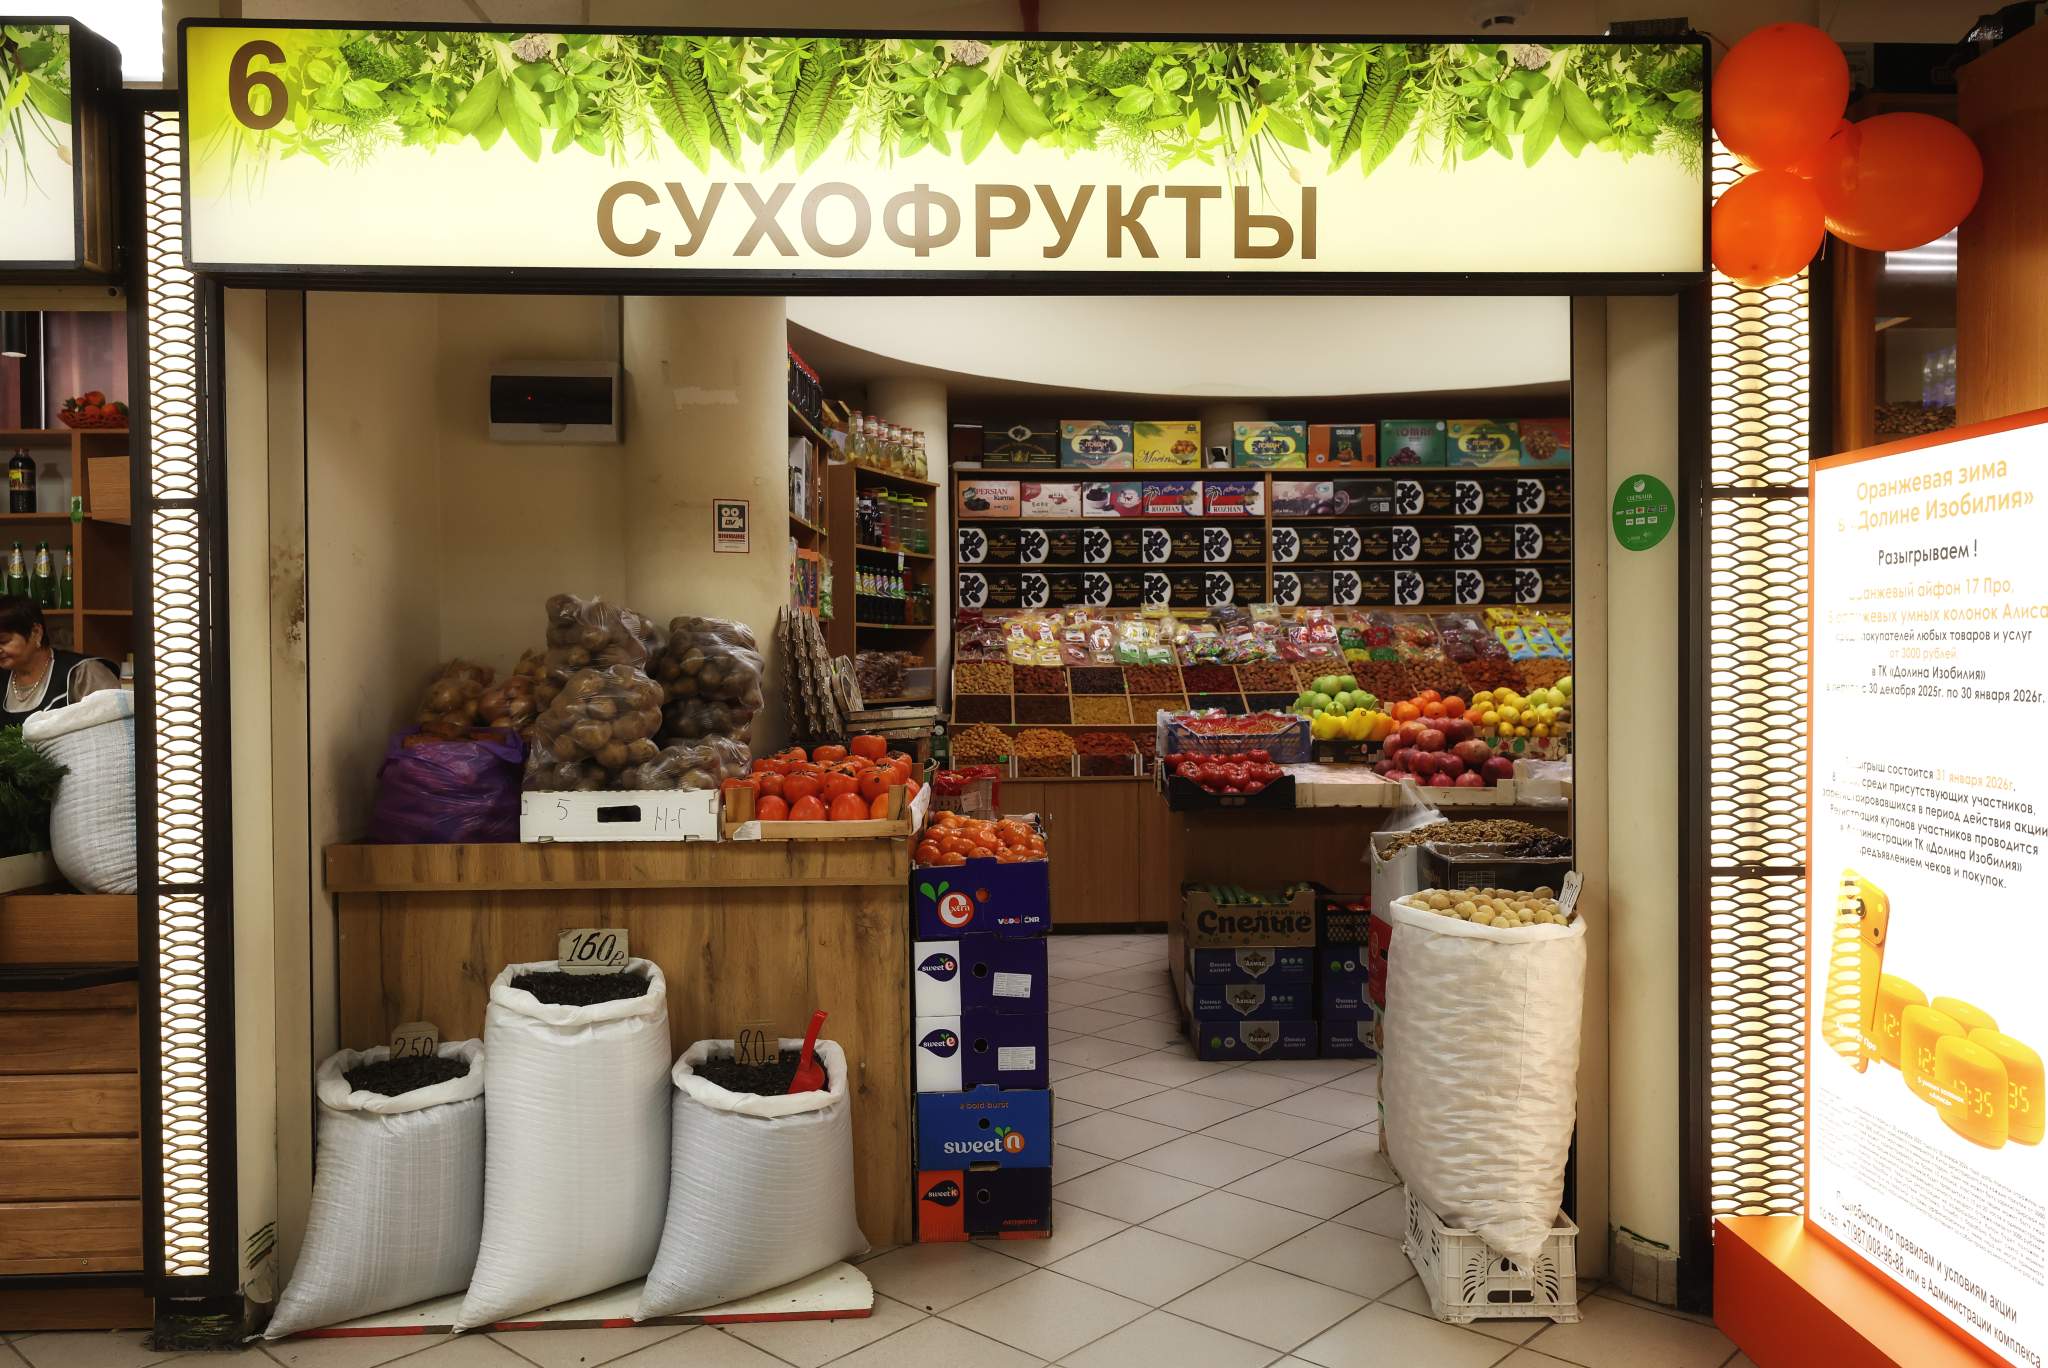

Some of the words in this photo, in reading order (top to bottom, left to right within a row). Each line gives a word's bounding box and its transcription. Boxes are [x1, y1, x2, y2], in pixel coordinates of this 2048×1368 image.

[228, 40, 288, 130] 6
[596, 181, 1317, 260] СУХОФРУКТЫ
[1857, 469, 1953, 504] Оранжевая
[1958, 459, 2007, 484] зима
[1856, 505, 1920, 531] Долине
[1925, 490, 2034, 520] Изобилия»
[1878, 545, 1969, 567] Разыгрываем
[1849, 580, 1914, 600] анжевый
[1917, 580, 1961, 599] айфон
[1966, 578, 1979, 594] 17
[1901, 609, 1940, 625] умных
[1943, 606, 1998, 621] колонок
[1917, 629, 1947, 641] любых
[1949, 630, 1991, 643] товаров
[1993, 630, 2000, 640] и
[2003, 630, 2032, 643] услуг
[1878, 665, 1887, 677] ТК
[1889, 665, 1930, 680] «Долина
[1932, 666, 1986, 681] Изобилия»
[1869, 683, 1878, 695] 30
[1880, 684, 1916, 698] декабря
[1946, 688, 1958, 699] по
[1961, 686, 1972, 699] 30
[1974, 688, 2010, 703] января
[1887, 763, 1934, 780] состоится
[1936, 768, 1945, 780] 31
[1949, 773, 1983, 790] января
[1862, 779, 1887, 791] среди
[1889, 781, 1969, 805] присутствующих
[556, 798, 572, 821] 5
[1918, 806, 1923, 815] в
[1925, 806, 1961, 823] период
[1963, 813, 2011, 832] действия
[1880, 816, 1915, 834] купонов
[1917, 822, 1972, 843] участников
[1975, 834, 2039, 857] проводится
[1859, 845, 1923, 869] редъявлением
[1924, 859, 1952, 876] чеков
[1962, 870, 2007, 889] покупок.
[1914, 838, 1924, 851] ТК
[1926, 842, 1967, 861] «Долина
[1969, 850, 2023, 873] Изобилия»
[1197, 910, 1312, 936] Спелые
[394, 1037, 434, 1060] 250
[1884, 1225, 1894, 1240] по
[1895, 1232, 1935, 1268] правилам
[1936, 1258, 1942, 1271] и
[1944, 1264, 1988, 1303] условиям
[1989, 1294, 2018, 1324] акции
[1906, 1265, 1920, 1283] или
[1921, 1276, 1927, 1289] в
[1928, 1279, 1992, 1334] Администрации
[1994, 1327, 2041, 1368] комплекса
